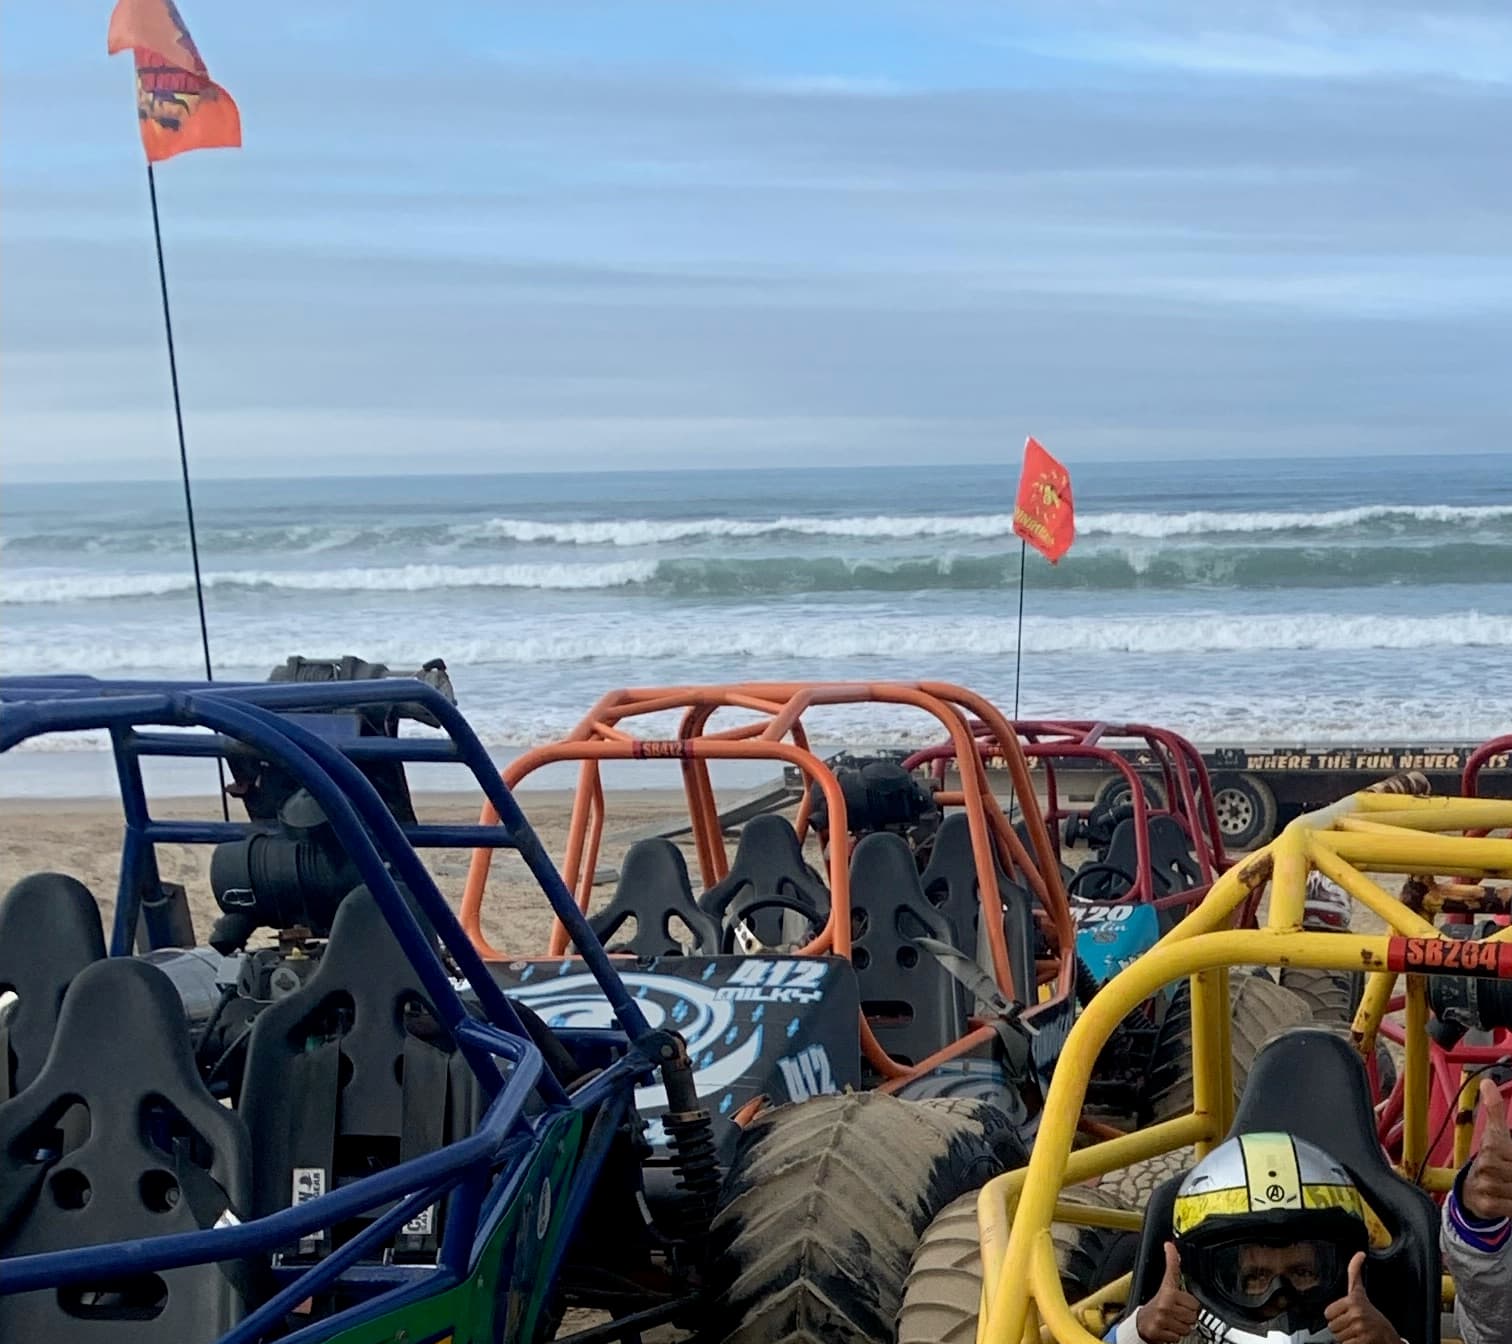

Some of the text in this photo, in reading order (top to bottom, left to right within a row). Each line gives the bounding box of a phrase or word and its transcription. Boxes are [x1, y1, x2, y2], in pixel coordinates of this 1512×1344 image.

[1247, 755, 1311, 769] WHERE
[1318, 755, 1350, 769] THE
[1356, 755, 1394, 769] FUN
[1400, 754, 1460, 769] NEVER
[726, 959, 829, 988] 412
[714, 987, 823, 1003] MILKY
